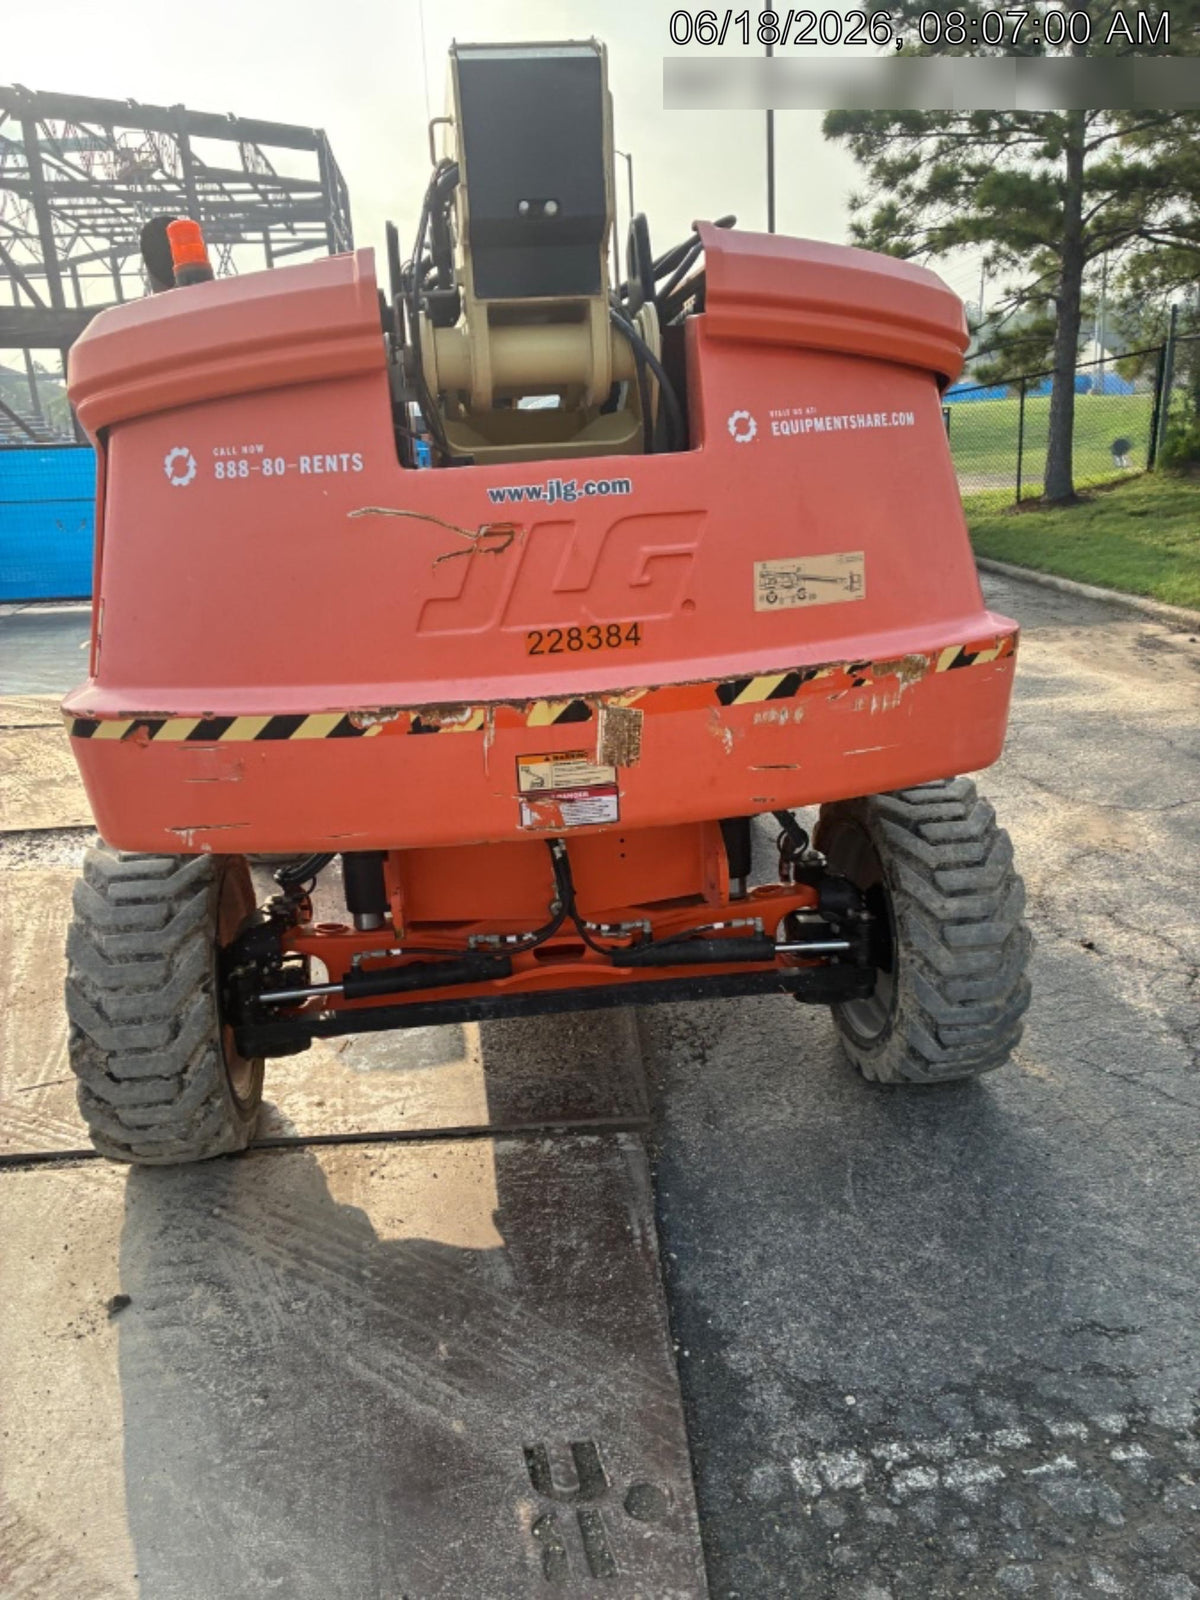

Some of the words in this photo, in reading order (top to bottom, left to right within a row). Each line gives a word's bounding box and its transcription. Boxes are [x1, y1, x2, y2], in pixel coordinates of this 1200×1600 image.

[771, 411, 915, 436] EQUIPMENTSHARE.COM
[212, 446, 237, 456] CALL
[241, 443, 265, 454] NOW
[214, 453, 364, 479] 888-80-RENTS
[487, 477, 632, 503] www.jlg.com
[527, 622, 641, 655] 228384
